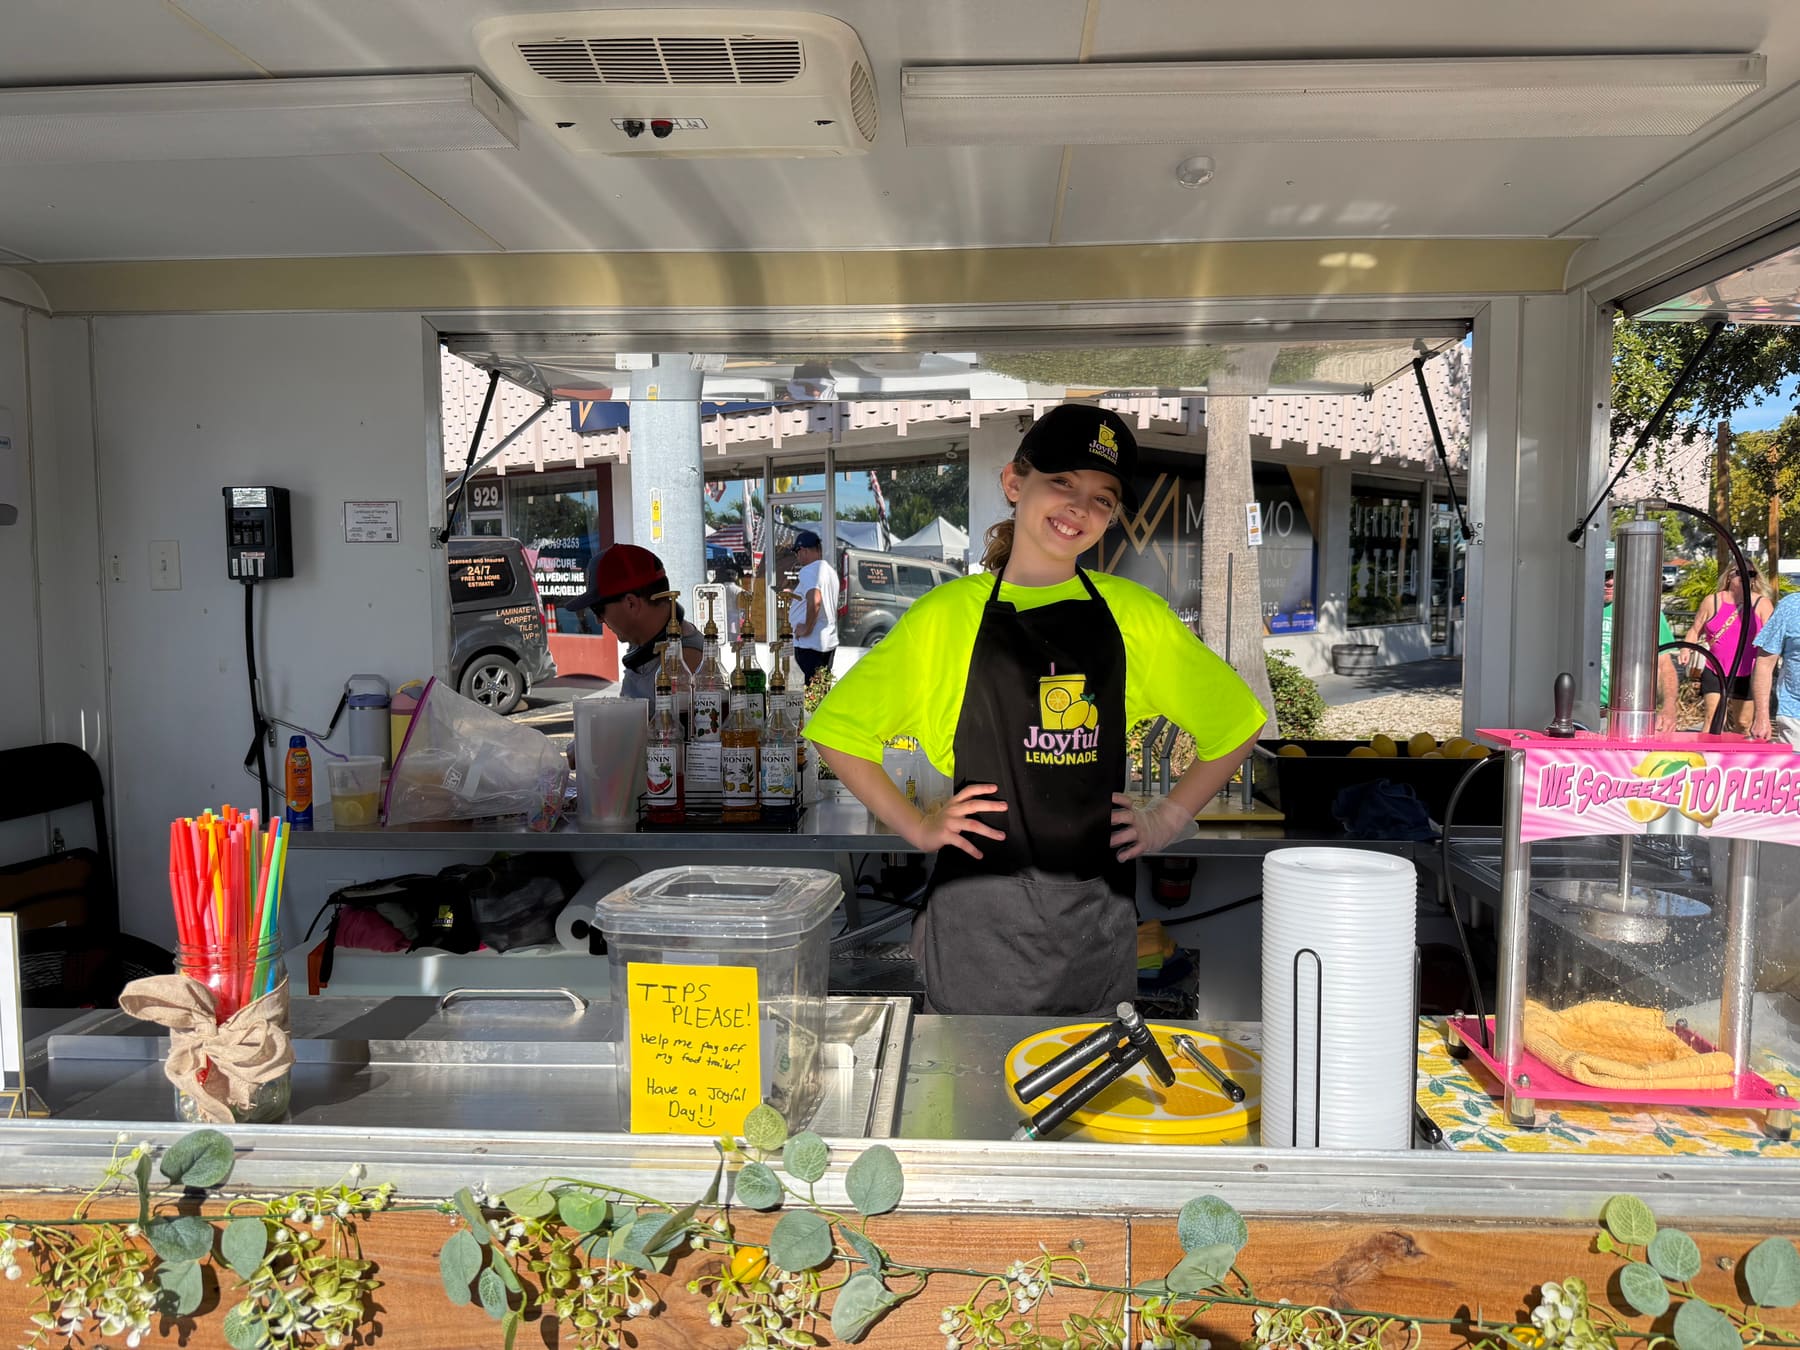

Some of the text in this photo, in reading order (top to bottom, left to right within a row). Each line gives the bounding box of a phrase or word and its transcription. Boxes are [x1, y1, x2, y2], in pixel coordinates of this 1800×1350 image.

[1089, 440, 1119, 460] Joyful
[473, 487, 499, 507] 929
[467, 565, 491, 576] 24/7
[496, 606, 530, 617] LAMINATE
[504, 615, 531, 625] CARPET
[520, 624, 533, 632] TILE
[1023, 724, 1100, 756] Joyful
[1025, 750, 1098, 765] LEMONADE
[1538, 764, 1576, 808] WE
[1688, 766, 1721, 813] TO
[636, 982, 711, 1004] TIPS
[672, 1002, 752, 1029] PLEASE!
[640, 1033, 747, 1055] Help me pay off
[655, 1053, 741, 1075] my food trailer!
[646, 1077, 747, 1104] Have a Joyful
[668, 1100, 714, 1122] Day!!
